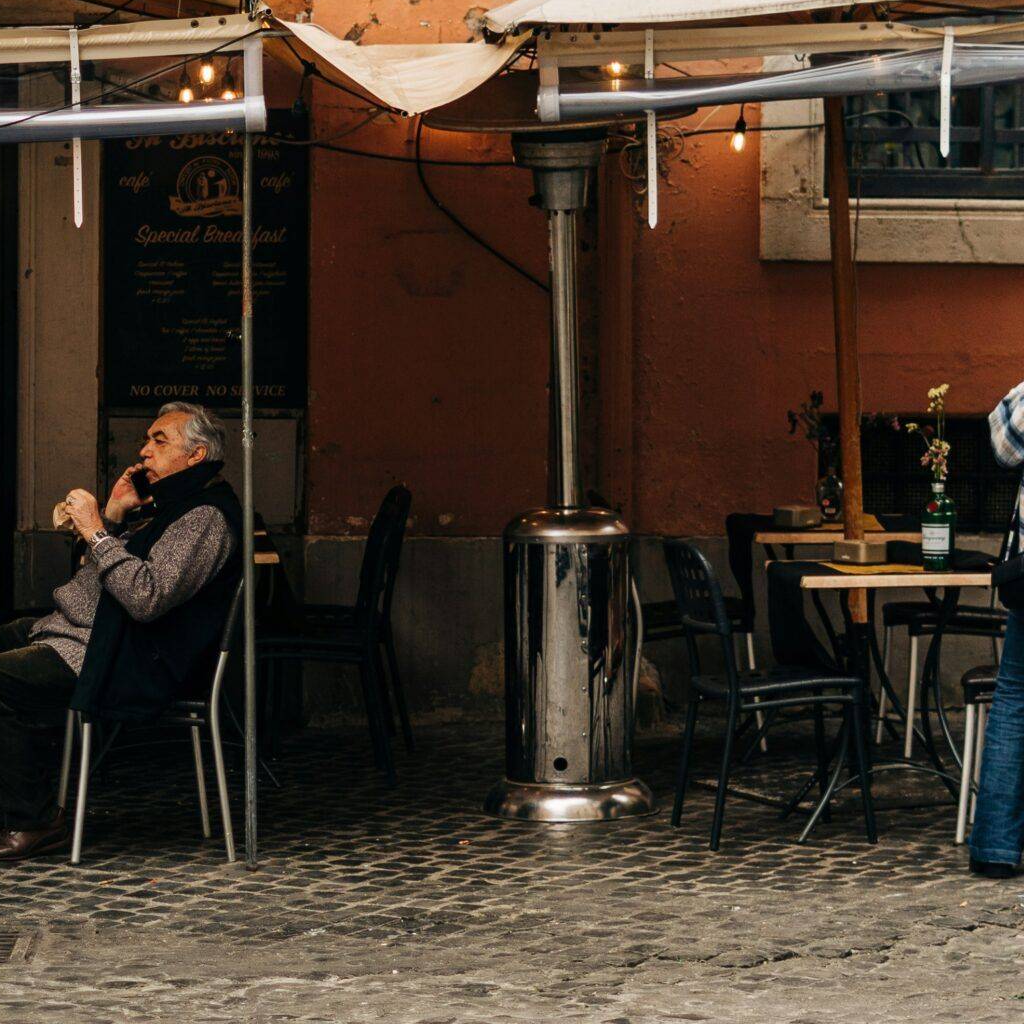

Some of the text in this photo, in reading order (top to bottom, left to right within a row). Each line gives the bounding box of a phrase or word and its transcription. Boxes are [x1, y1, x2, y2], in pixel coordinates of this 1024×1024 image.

[134, 224, 288, 250] Special Breafast
[130, 384, 151, 397] NO
[154, 384, 199, 397] COVER
[206, 384, 228, 397] NO
